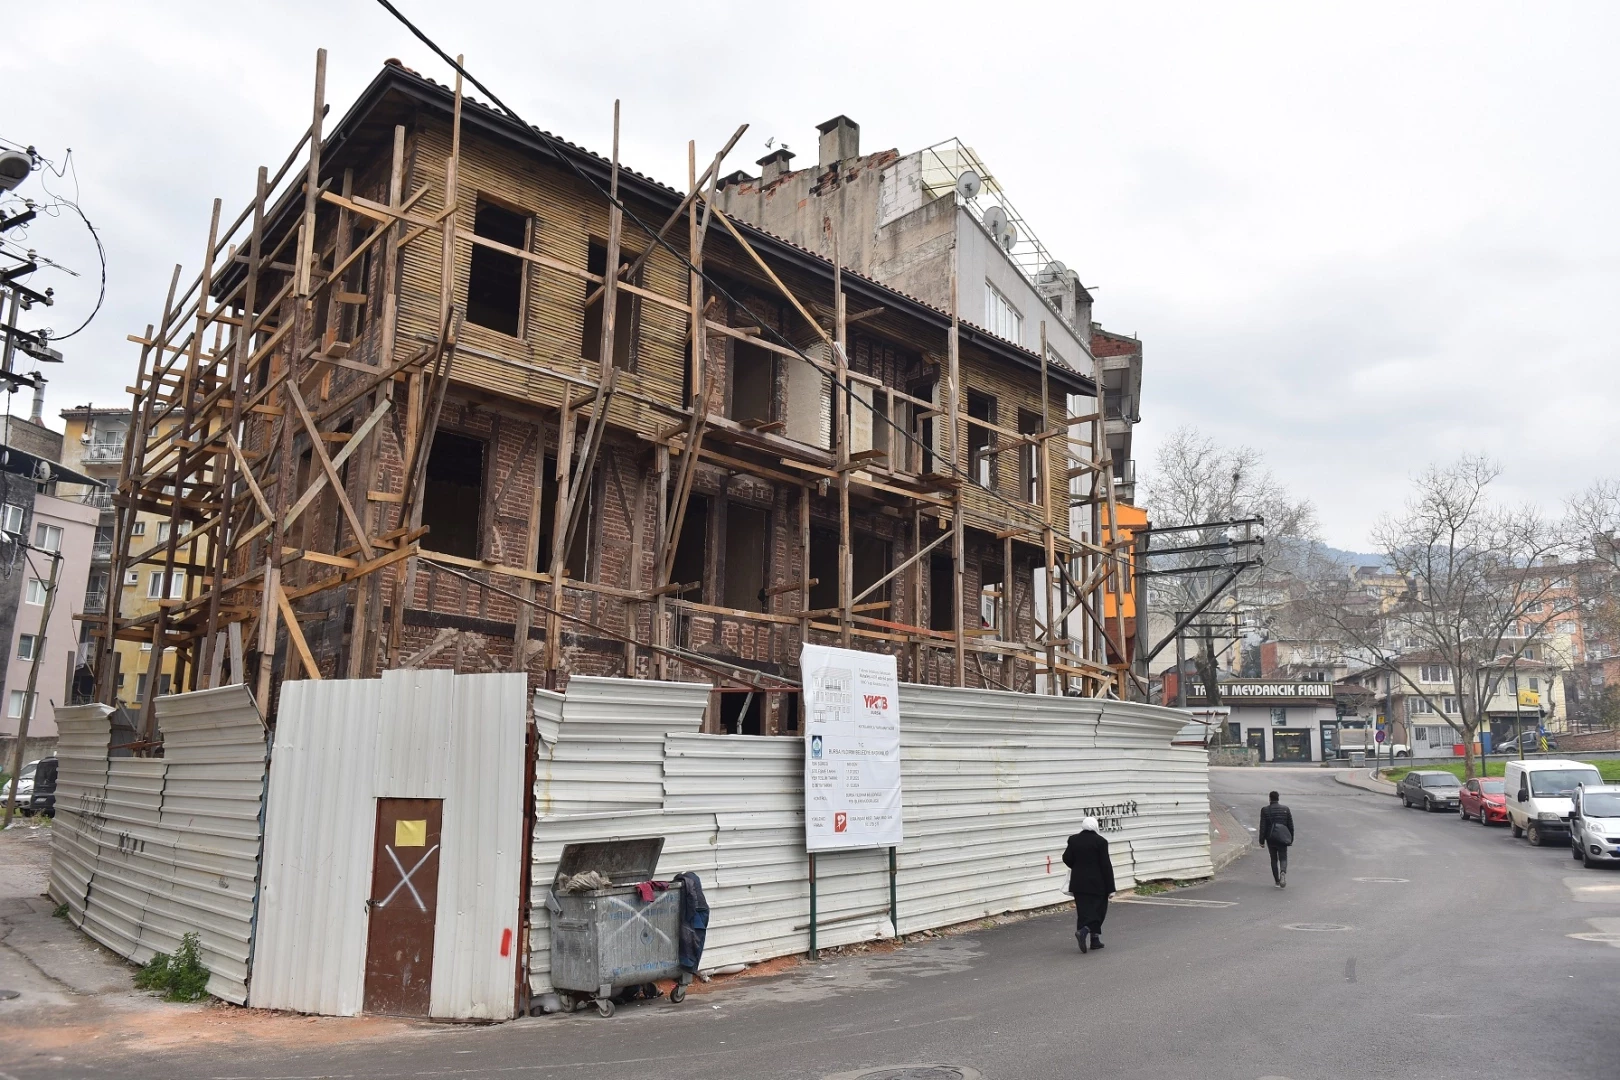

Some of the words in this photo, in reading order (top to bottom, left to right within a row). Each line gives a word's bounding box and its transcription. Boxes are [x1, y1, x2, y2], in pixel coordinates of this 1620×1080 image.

[1231, 684, 1295, 696] MEYDANCIK
[1298, 684, 1330, 696] FIRINI
[1083, 799, 1139, 816] NASİHATLER
